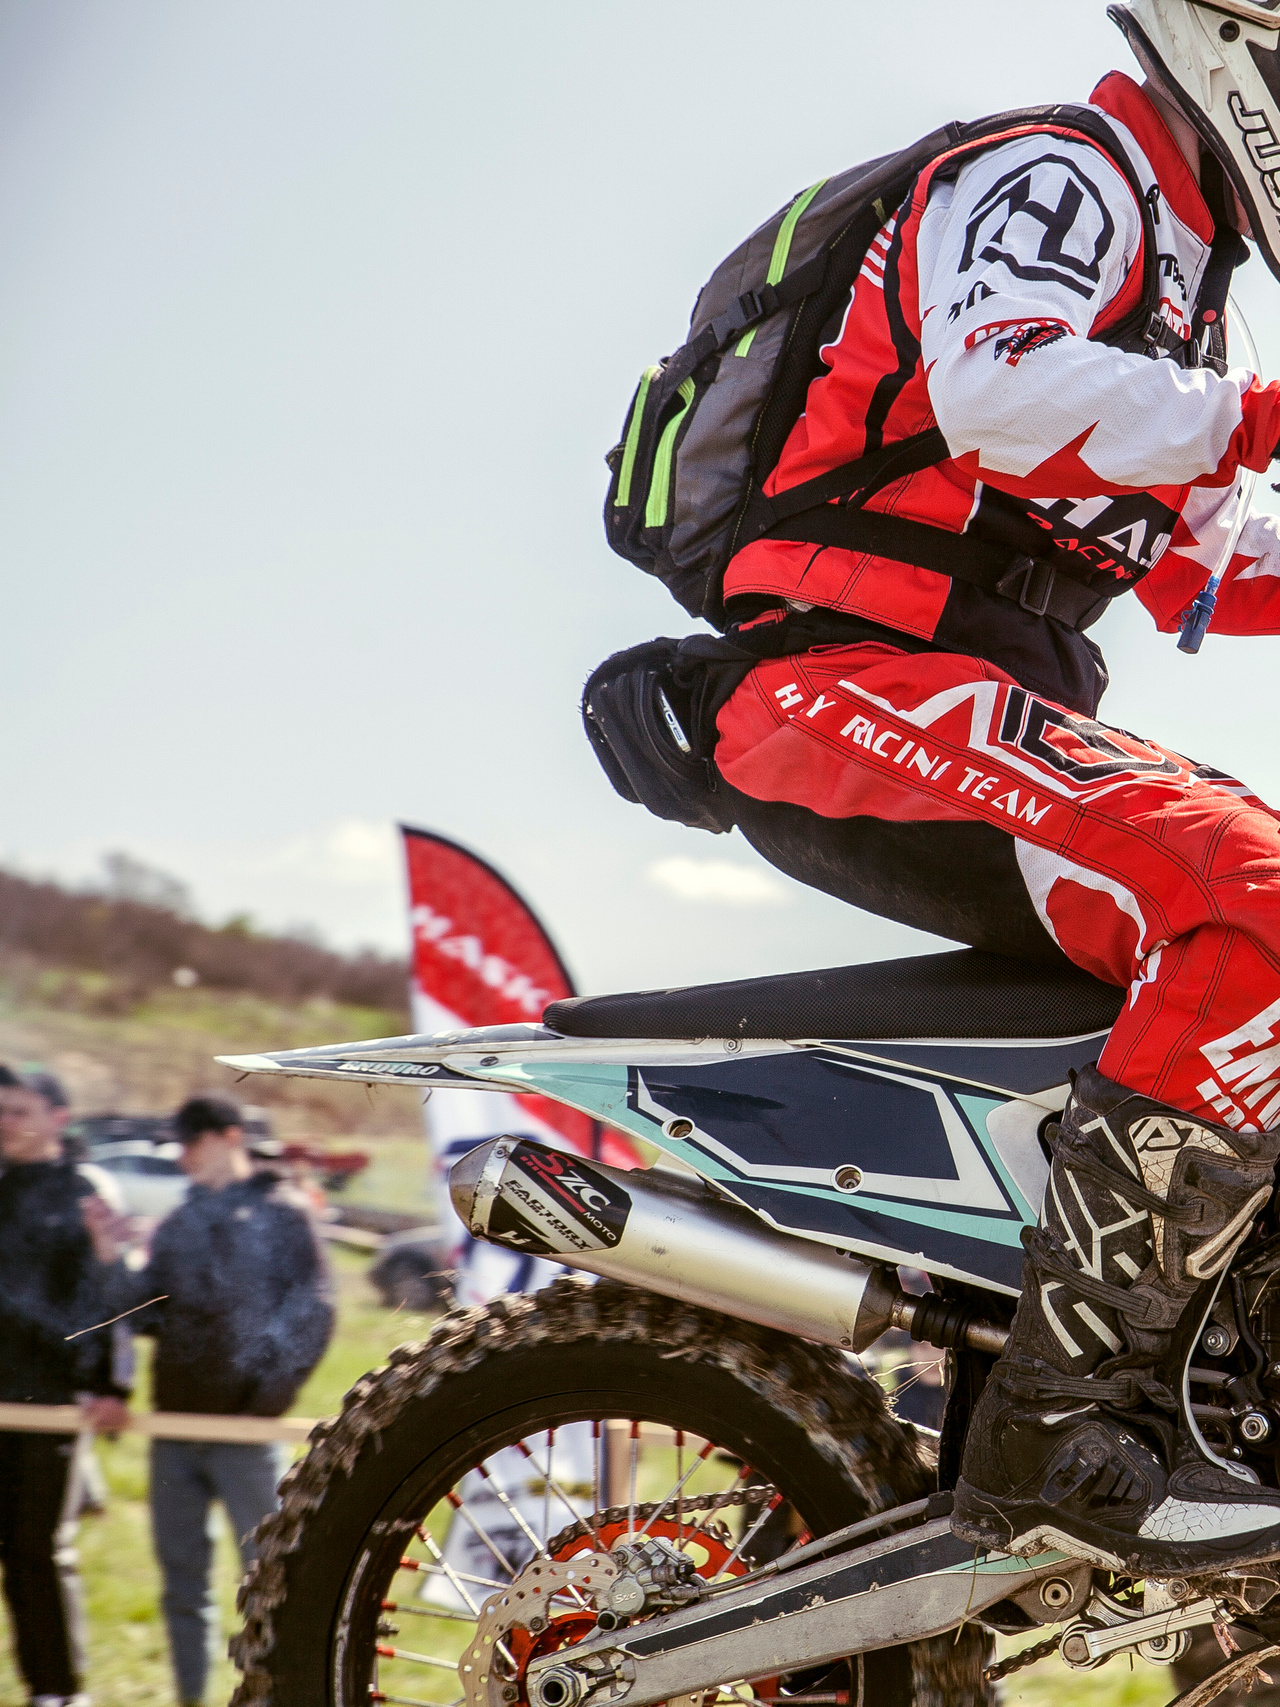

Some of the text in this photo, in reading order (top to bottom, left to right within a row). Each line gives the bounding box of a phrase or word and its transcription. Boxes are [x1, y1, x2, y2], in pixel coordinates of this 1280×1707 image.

[957, 766, 1052, 826] TEAM
[337, 1061, 440, 1076] ENDURO
[504, 1179, 593, 1249] FACTORY
[583, 1211, 617, 1241] MOTO
